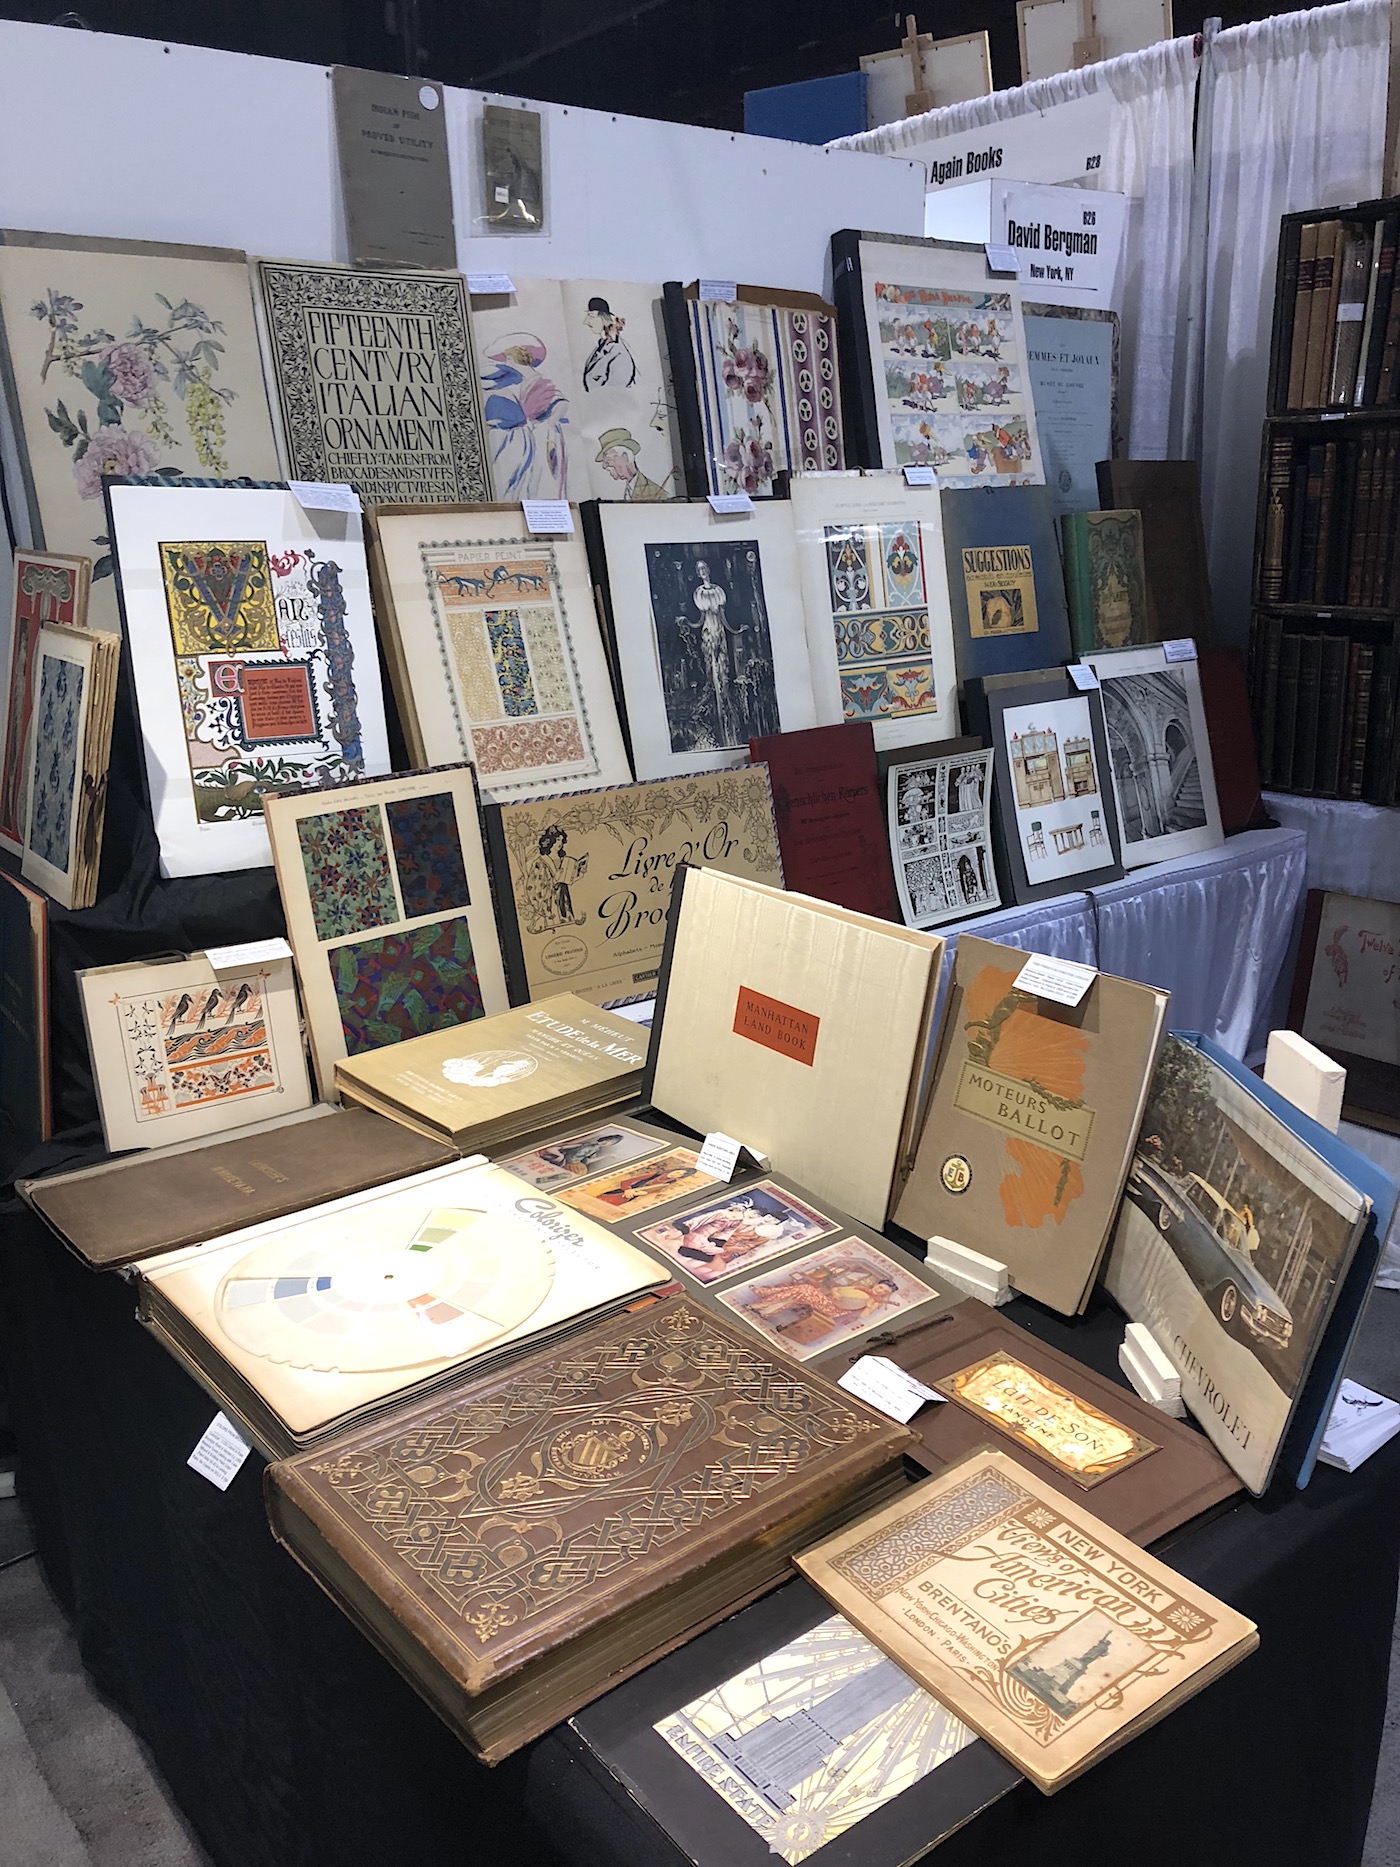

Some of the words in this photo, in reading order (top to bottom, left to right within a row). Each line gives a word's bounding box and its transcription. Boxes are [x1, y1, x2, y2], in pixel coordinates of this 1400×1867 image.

[930, 156, 963, 185] Again
[966, 146, 1003, 175] Books
[1008, 220, 1041, 250] David
[1044, 224, 1098, 257] Bergman
[1030, 263, 1045, 279] New
[1046, 265, 1063, 282] York,
[1065, 267, 1075, 281] NY
[308, 312, 436, 351] FIFTEENTH
[314, 347, 437, 384] CENTVRY
[1027, 350, 1057, 362] EMMES
[1060, 352, 1070, 364] ET
[319, 383, 445, 418] ITALIAN
[324, 418, 448, 451] ORNAMENT
[458, 552, 490, 562] PAPIER
[495, 550, 523, 561] PEINT
[964, 548, 1031, 573] SUGGESTIONS
[608, 836, 676, 881] Livre
[649, 876, 664, 893] de
[613, 947, 643, 958] Alphabets
[1358, 929, 1394, 956] Twelve
[1382, 964, 1396, 984] of
[744, 1015, 772, 1035] LAND
[777, 1029, 806, 1051] BOOK
[746, 1001, 809, 1035] MANHATTAN
[599, 1042, 643, 1066] MER
[968, 1073, 1047, 1114] MOTEURS
[997, 1102, 1081, 1147] BALLOT
[514, 1197, 584, 1247] Colorizer
[1173, 1334, 1256, 1451] CHEVROLET
[1001, 1403, 1055, 1439] LANOLINE
[1034, 1404, 1061, 1424] DE
[1060, 1421, 1105, 1452] SON
[1051, 1560, 1092, 1586] of
[1057, 1529, 1105, 1561] NEW
[1107, 1560, 1165, 1605] YORK
[898, 1585, 913, 1603] NEW
[930, 1545, 1138, 1628] American
[972, 1577, 1079, 1626] Cities
[917, 1579, 1013, 1656] BRENTANO'S
[665, 1724, 725, 1779] EMPIRE
[718, 1776, 777, 1831] STATE
